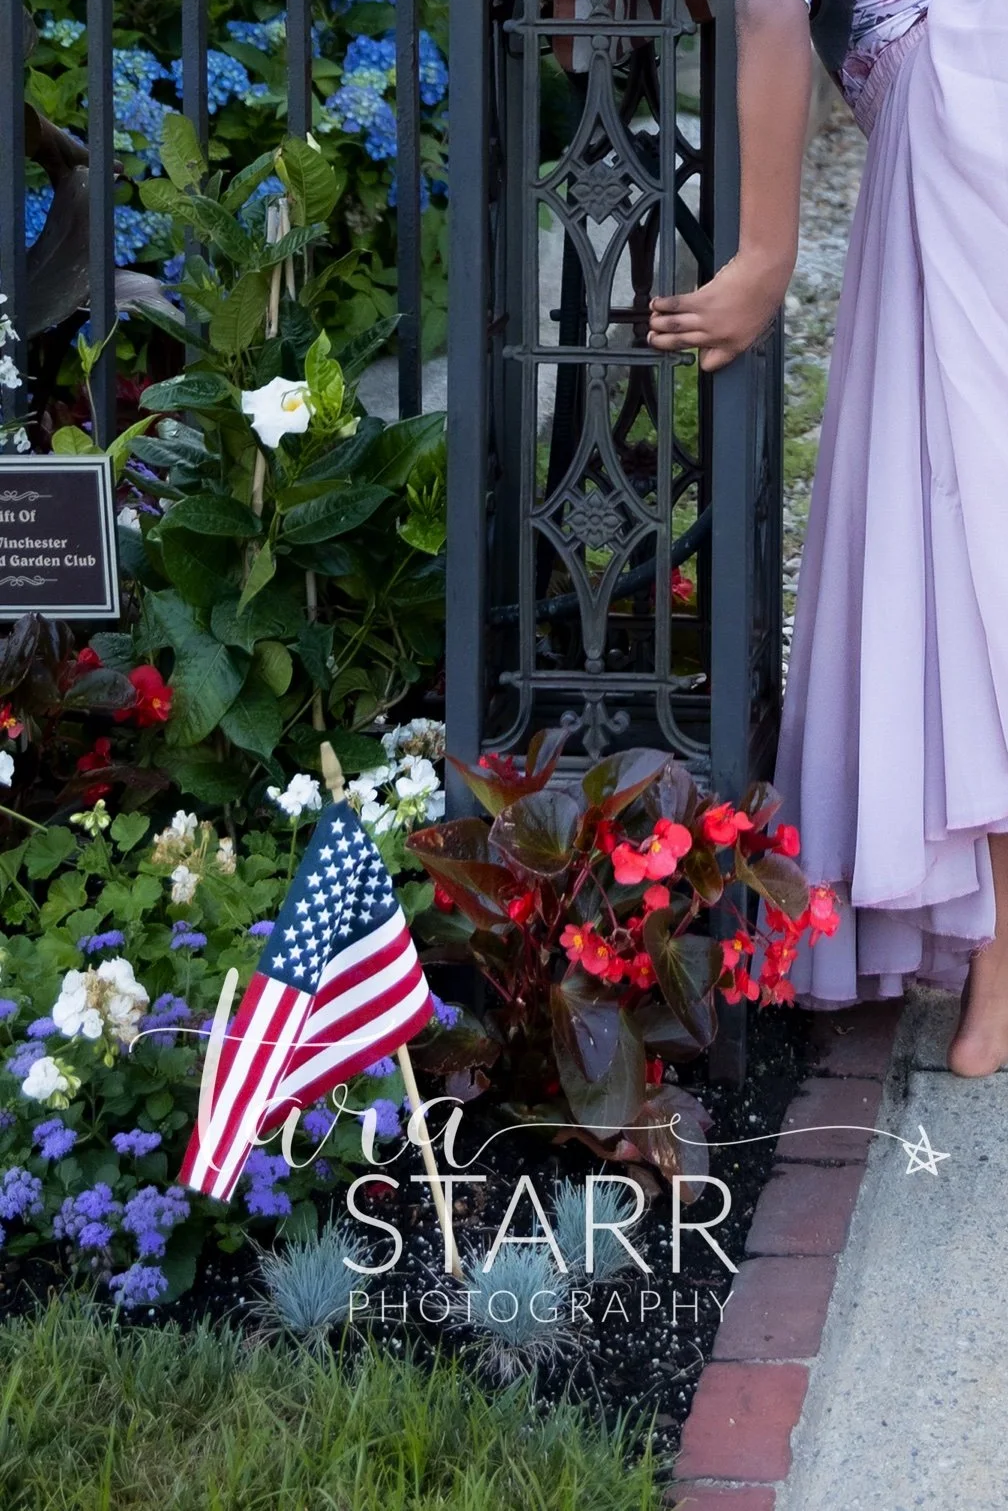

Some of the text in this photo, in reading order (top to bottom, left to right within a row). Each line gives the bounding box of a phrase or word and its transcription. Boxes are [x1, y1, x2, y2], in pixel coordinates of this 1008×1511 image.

[0, 510, 37, 522] ift Of
[0, 536, 68, 549] inchester
[9, 554, 61, 567] Garden
[64, 554, 97, 567] Club
